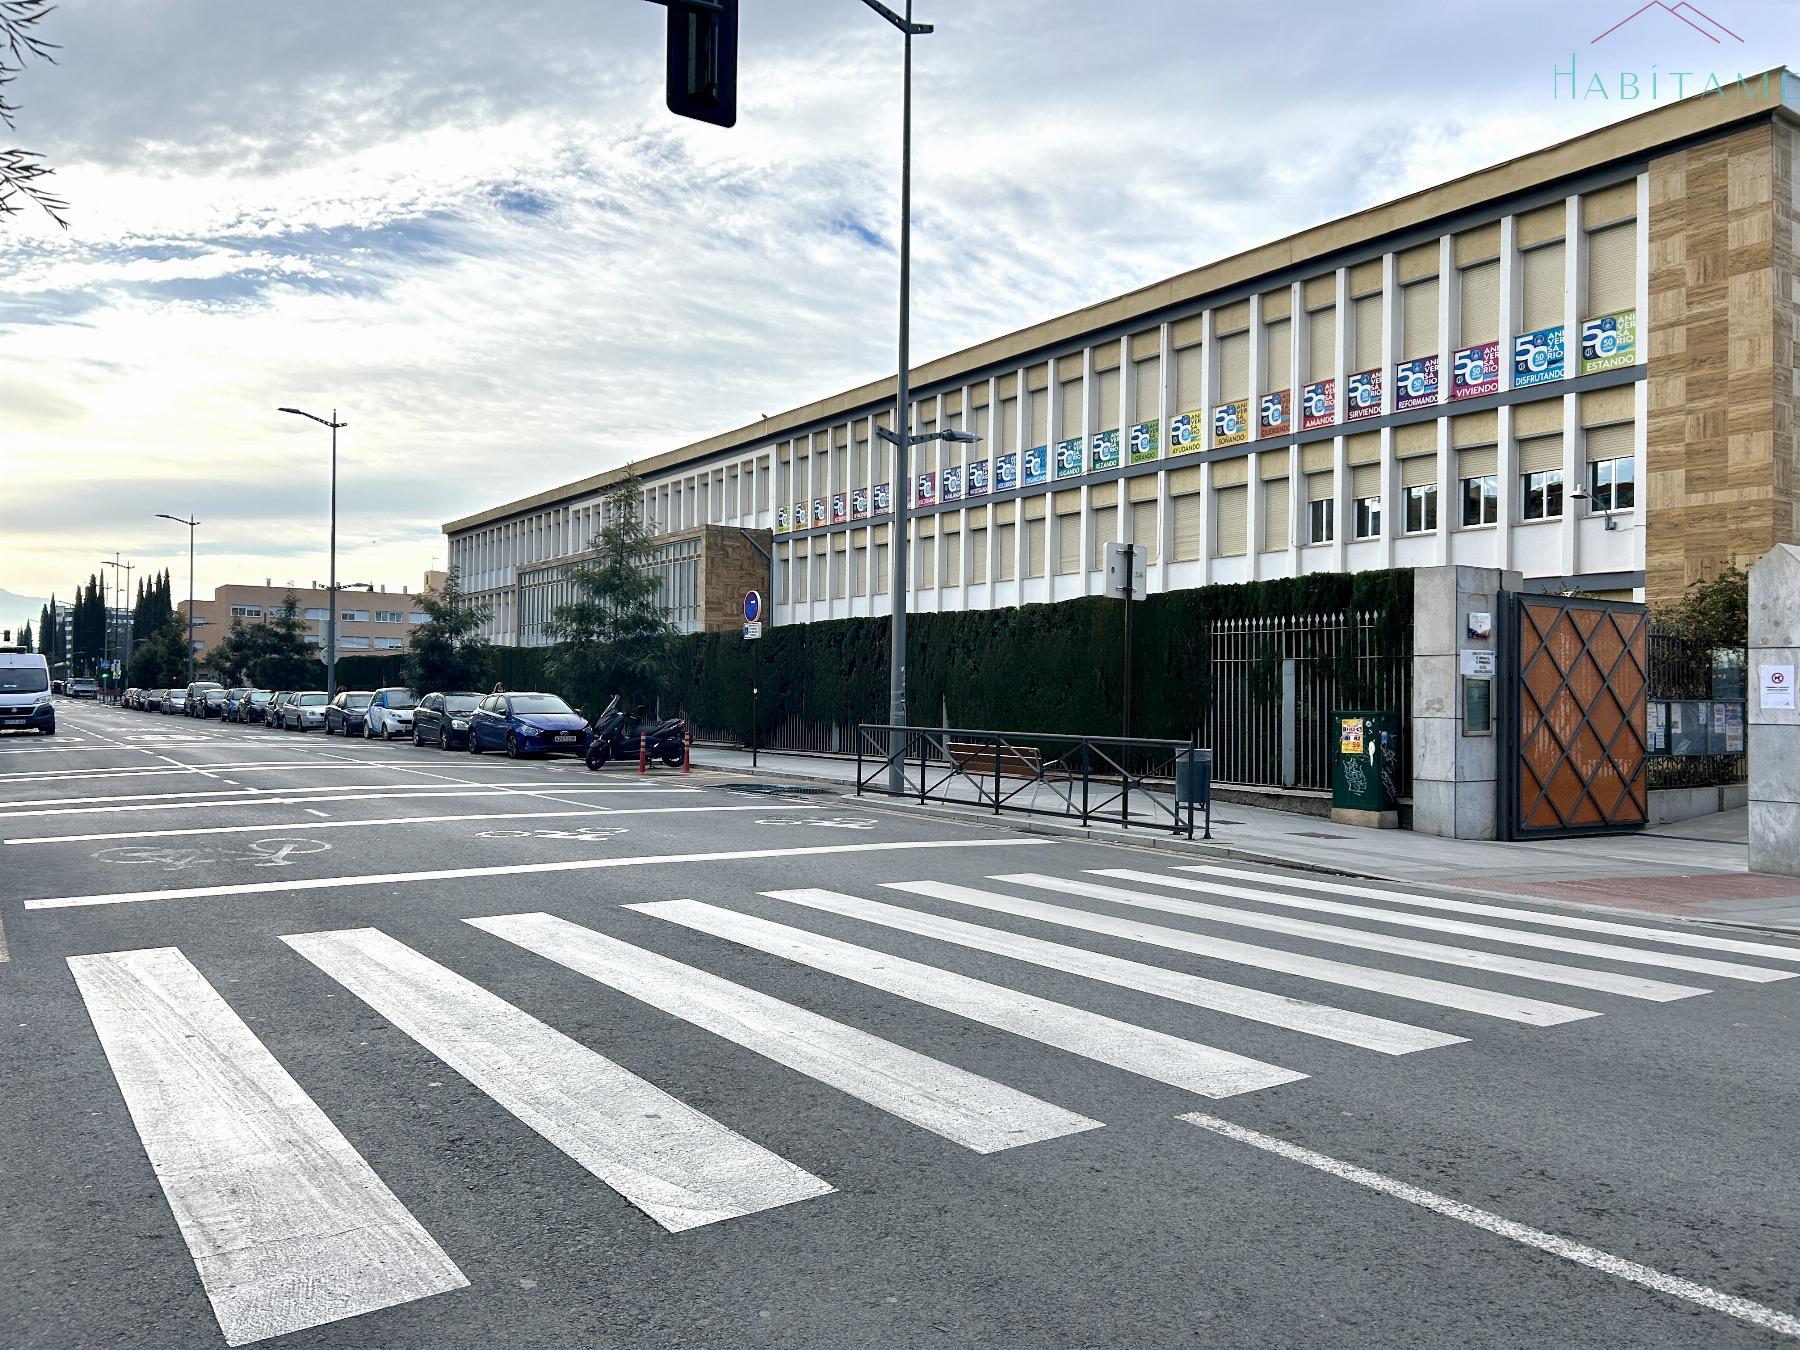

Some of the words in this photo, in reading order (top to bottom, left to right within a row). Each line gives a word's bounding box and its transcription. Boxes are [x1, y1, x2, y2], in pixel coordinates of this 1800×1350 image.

[1618, 314, 1635, 322] ANI
[1618, 321, 1636, 330] VER
[1583, 319, 1616, 357] 50
[1617, 335, 1633, 344] RIO
[1516, 335, 1547, 371] 50
[1548, 351, 1563, 359] RIO
[1455, 350, 1483, 385] 50
[1484, 365, 1498, 373] RIO
[1586, 354, 1634, 371] ESTANDO
[1398, 363, 1424, 396] 50
[1456, 383, 1497, 397] VIVIENDO
[1398, 394, 1439, 408] REFORMANDO
[1305, 415, 1335, 428] AMANDO
